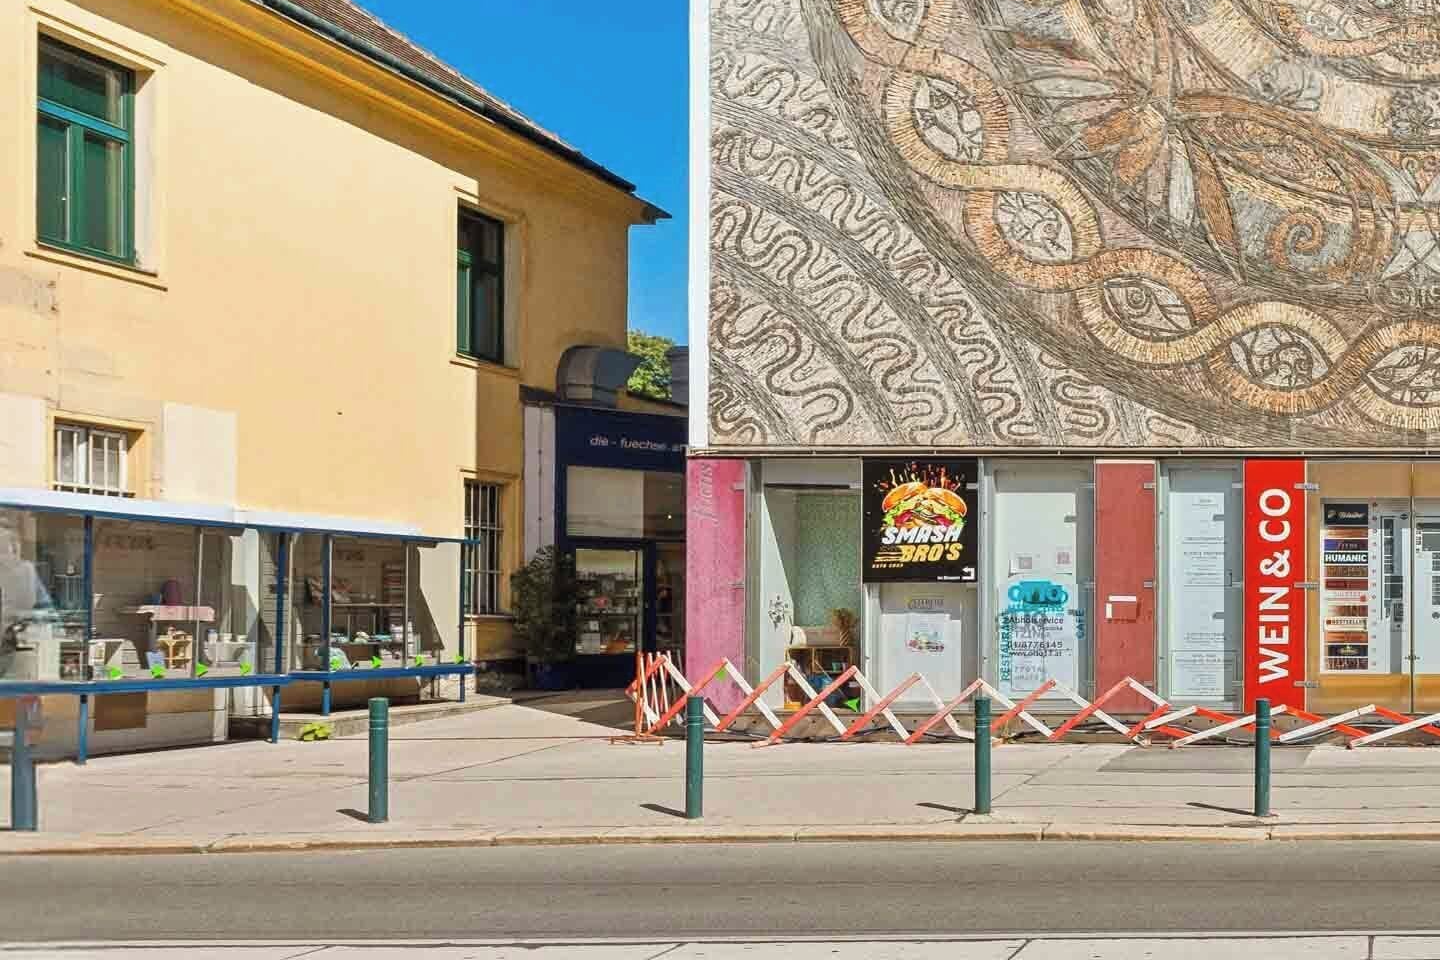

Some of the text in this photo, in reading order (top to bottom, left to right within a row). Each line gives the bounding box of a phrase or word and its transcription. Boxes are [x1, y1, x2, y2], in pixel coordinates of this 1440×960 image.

[881, 524, 964, 544] SMASH
[900, 542, 963, 562] BRO'S
[1325, 554, 1367, 563] HUMANIC
[1258, 488, 1291, 684] WEIN & CO
